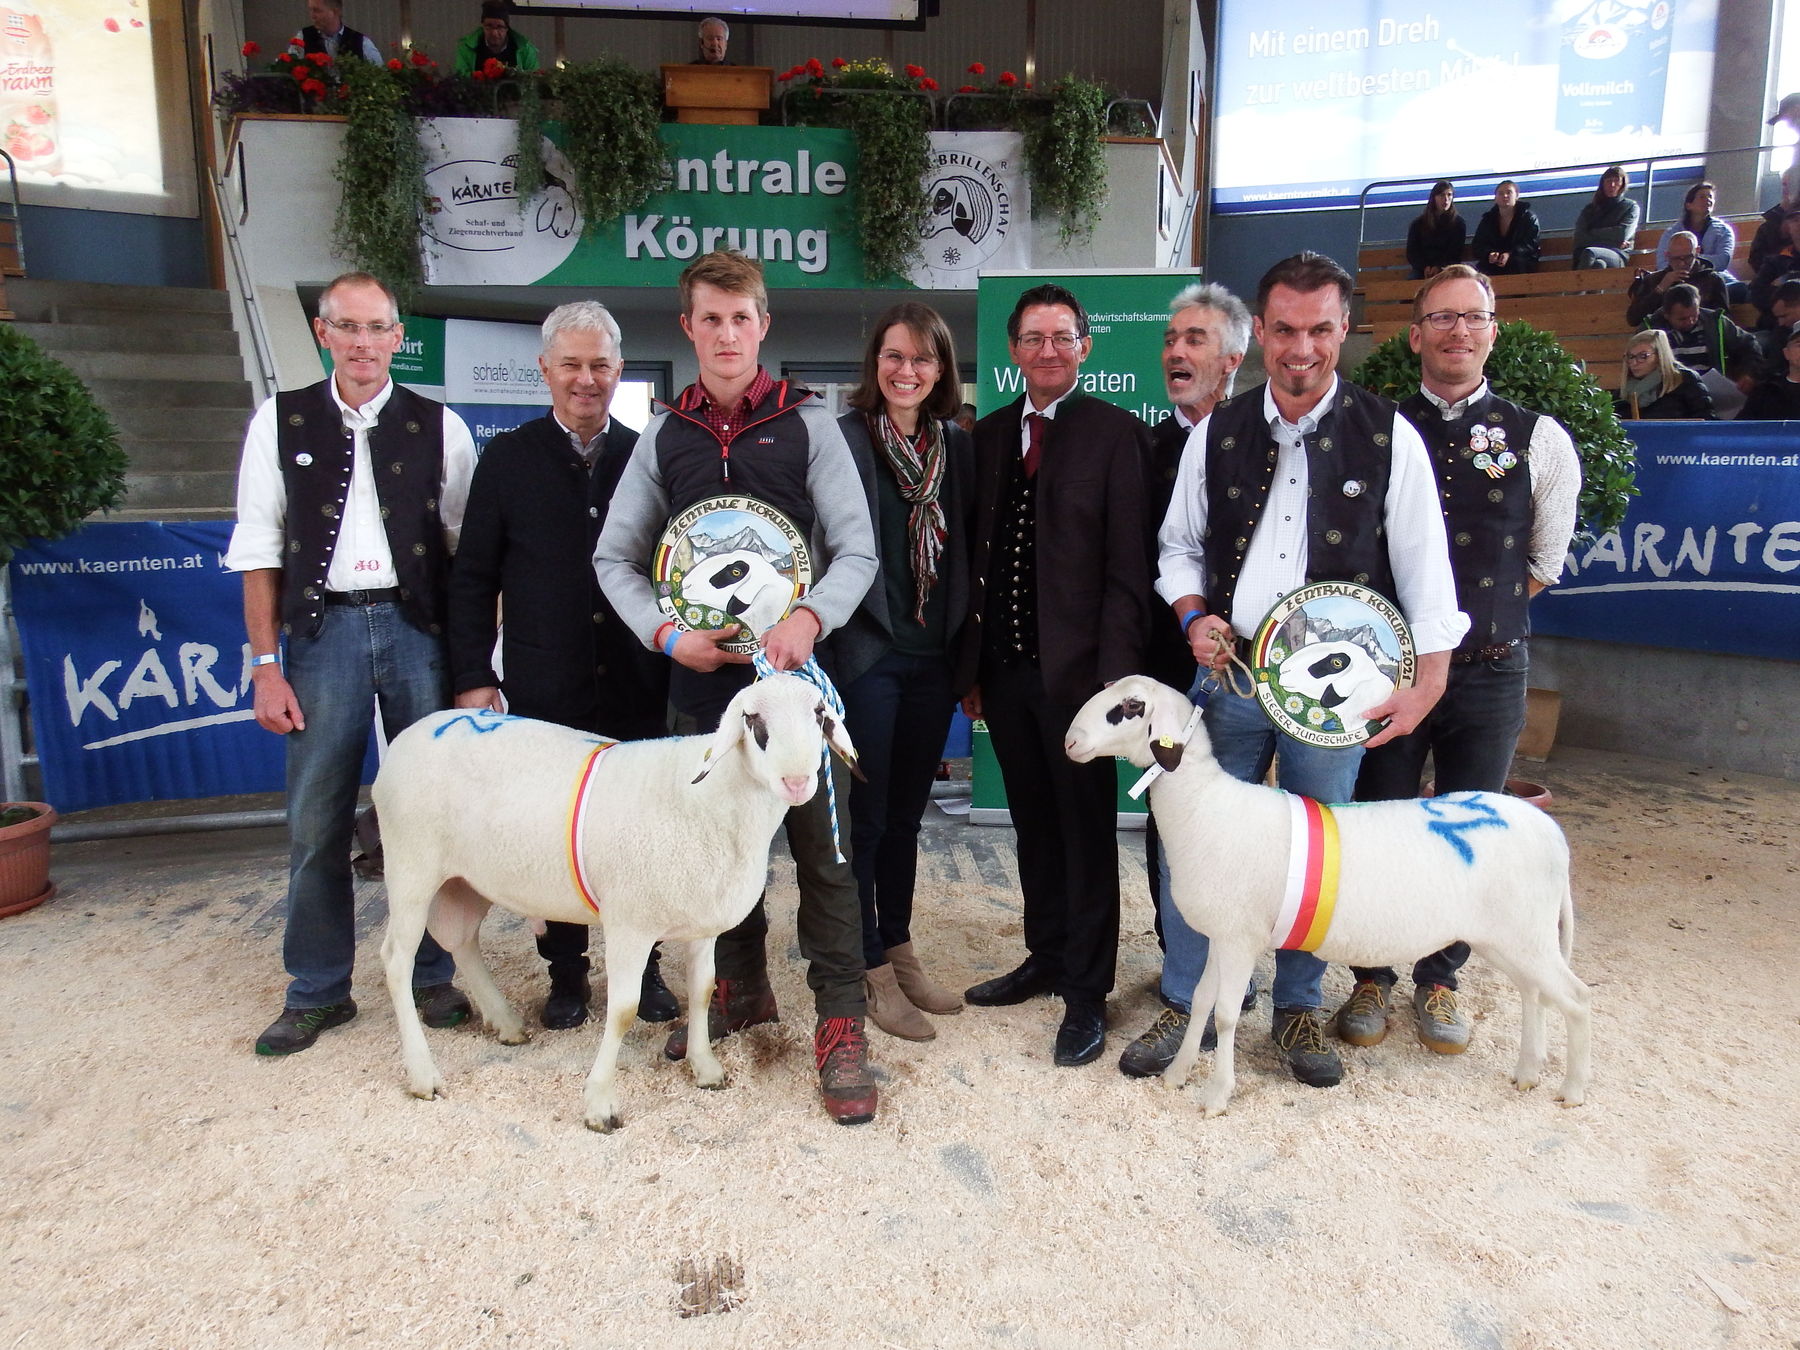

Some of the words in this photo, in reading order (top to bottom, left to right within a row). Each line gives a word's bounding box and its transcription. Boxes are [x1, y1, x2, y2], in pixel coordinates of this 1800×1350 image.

[1249, 29, 1286, 58] Mit
[1292, 25, 1370, 55] einem
[1378, 13, 1440, 46] Dreh
[2, 76, 54, 92] raum
[1246, 80, 1284, 105] zur
[1292, 67, 1431, 101] weltbesten
[1562, 80, 1634, 97] Vollmilch
[660, 149, 847, 195] ntrale
[448, 228, 524, 237] Ziegenzuchtverband
[491, 219, 506, 227] und
[625, 214, 829, 273] Körung
[1089, 325, 1111, 333] rnten
[1656, 452, 1799, 467] www.kaernten.at
[669, 499, 740, 539] ZENTRALE
[793, 543, 809, 572] 2021
[20, 553, 203, 576] www.kaernten.at
[1284, 584, 1363, 613] ZENTRALE
[1402, 650, 1413, 681] 2021
[1262, 692, 1292, 730] SIEGER
[1292, 727, 1364, 745] JUNGSCHAFE
